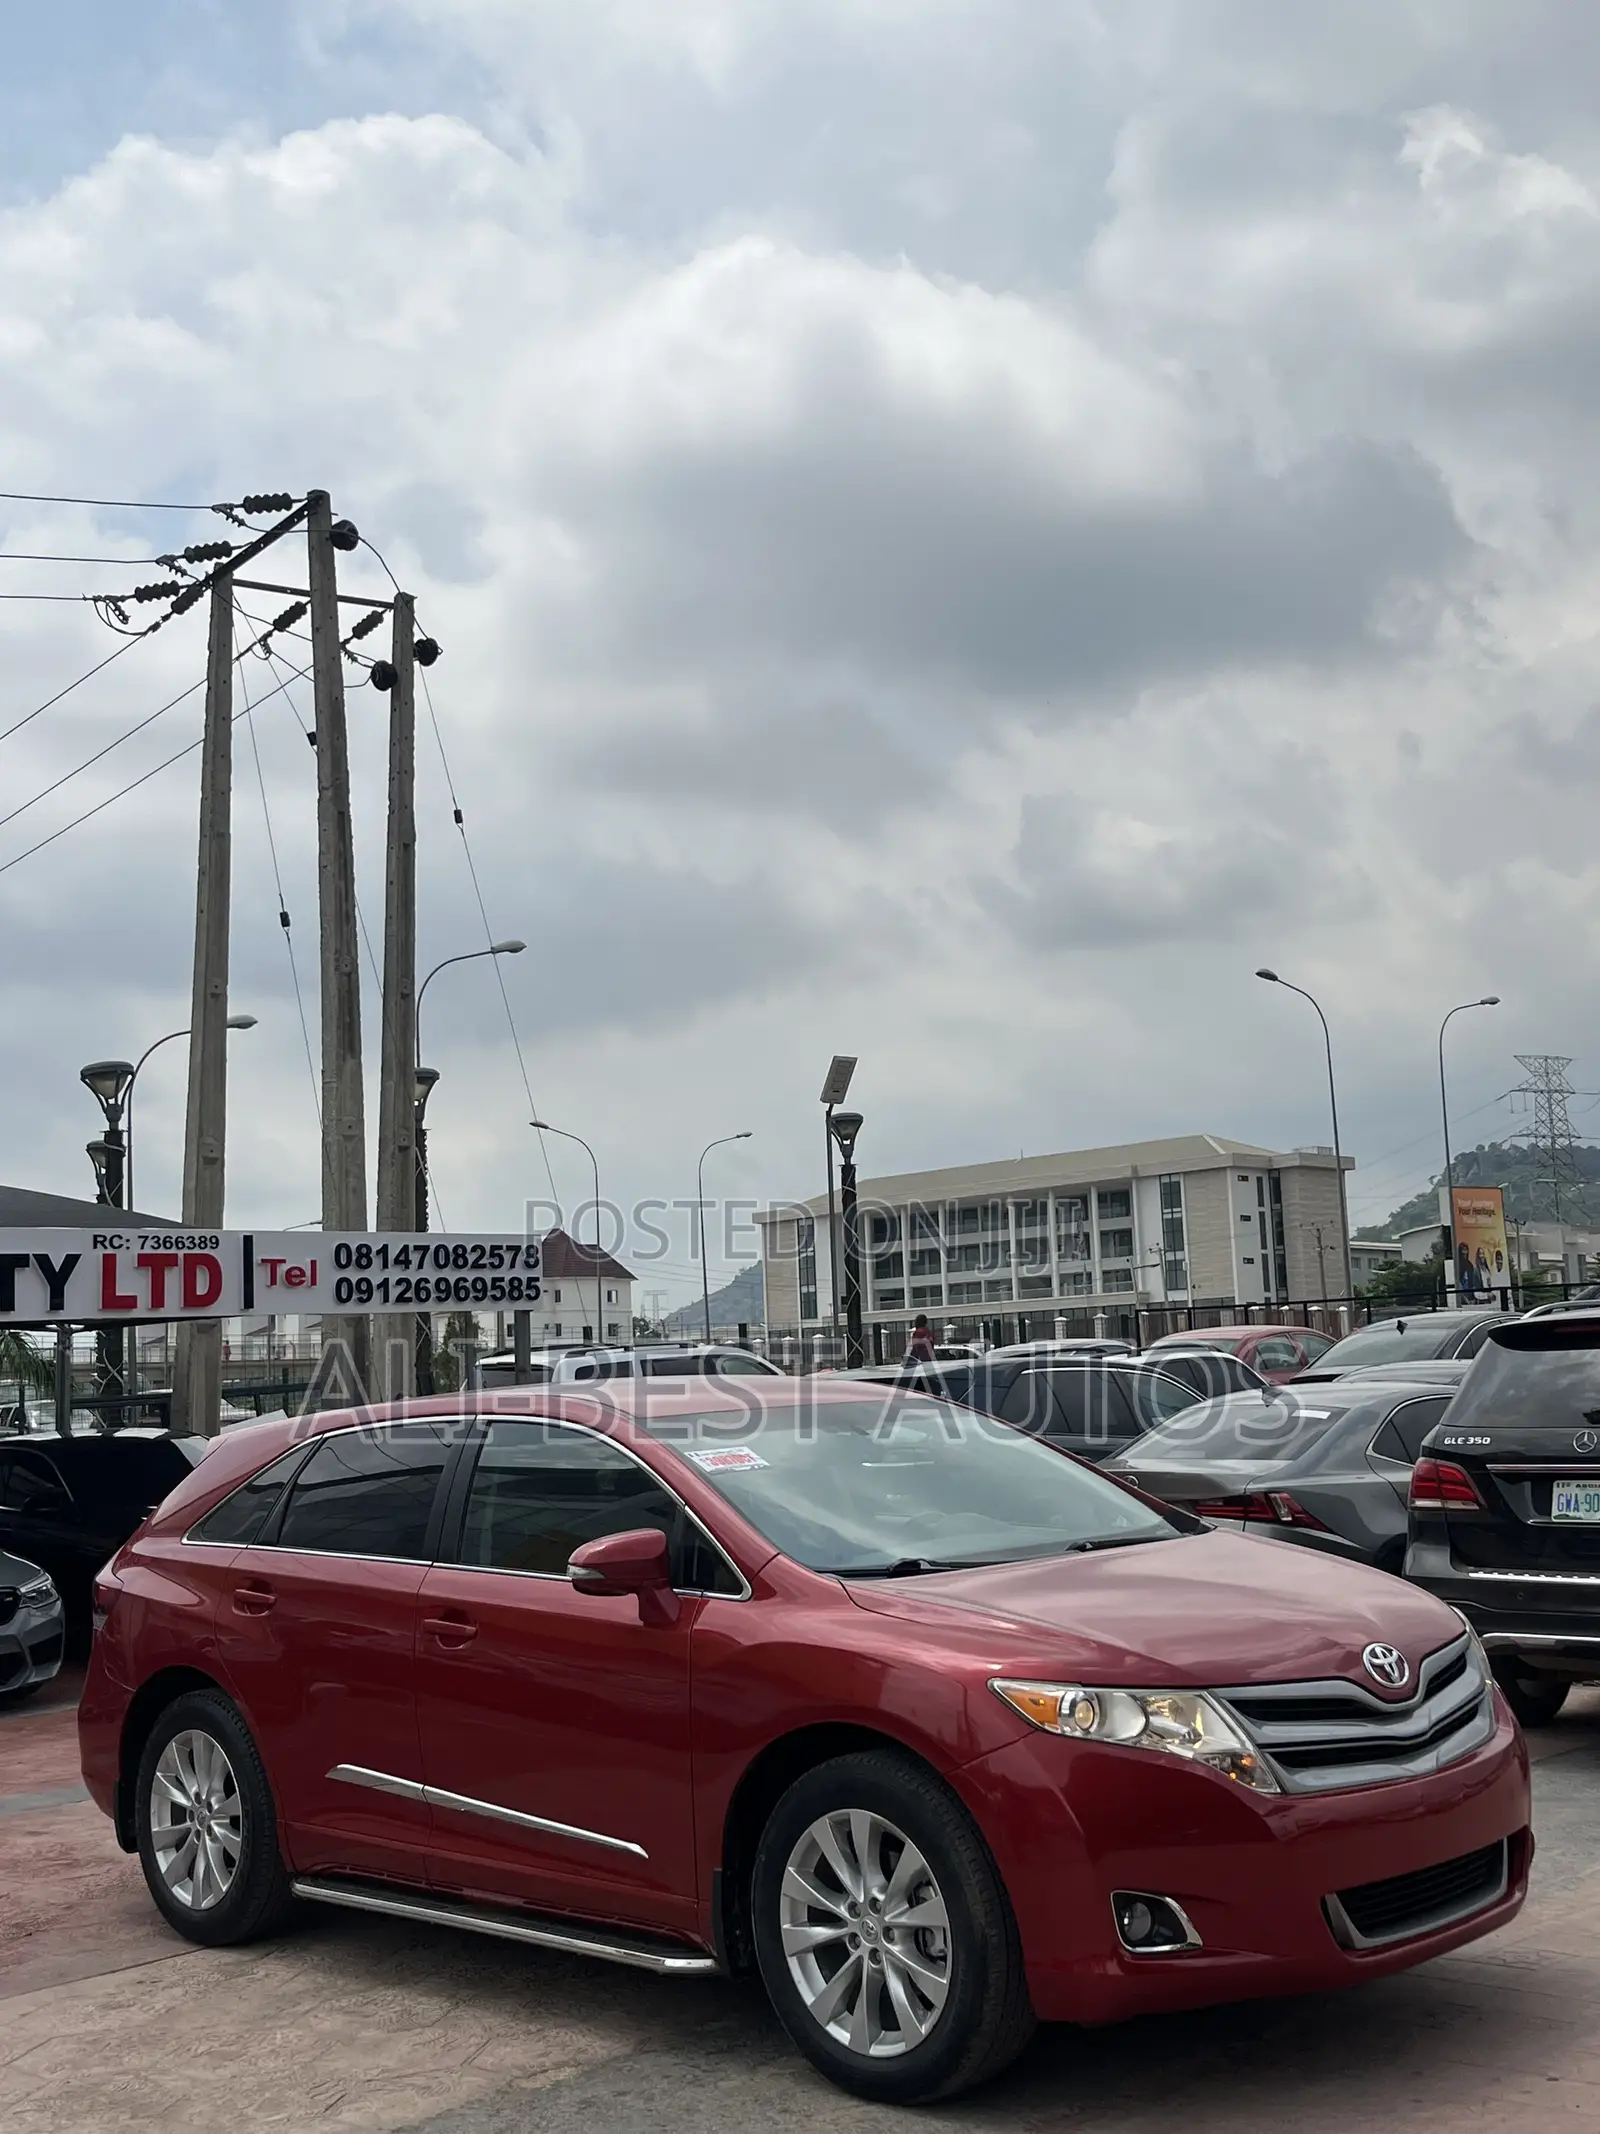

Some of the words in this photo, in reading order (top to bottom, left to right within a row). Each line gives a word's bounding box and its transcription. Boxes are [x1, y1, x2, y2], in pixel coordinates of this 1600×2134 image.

[92, 1234, 131, 1250] RC:
[137, 1235, 220, 1250] 7366389
[334, 1242, 540, 1270] 08147082578
[101, 1253, 223, 1309] LTD
[259, 1258, 318, 1287] Tel
[334, 1276, 541, 1304] 09126969585
[1443, 1436, 1466, 1445] GLE
[1466, 1436, 1491, 1445] 350
